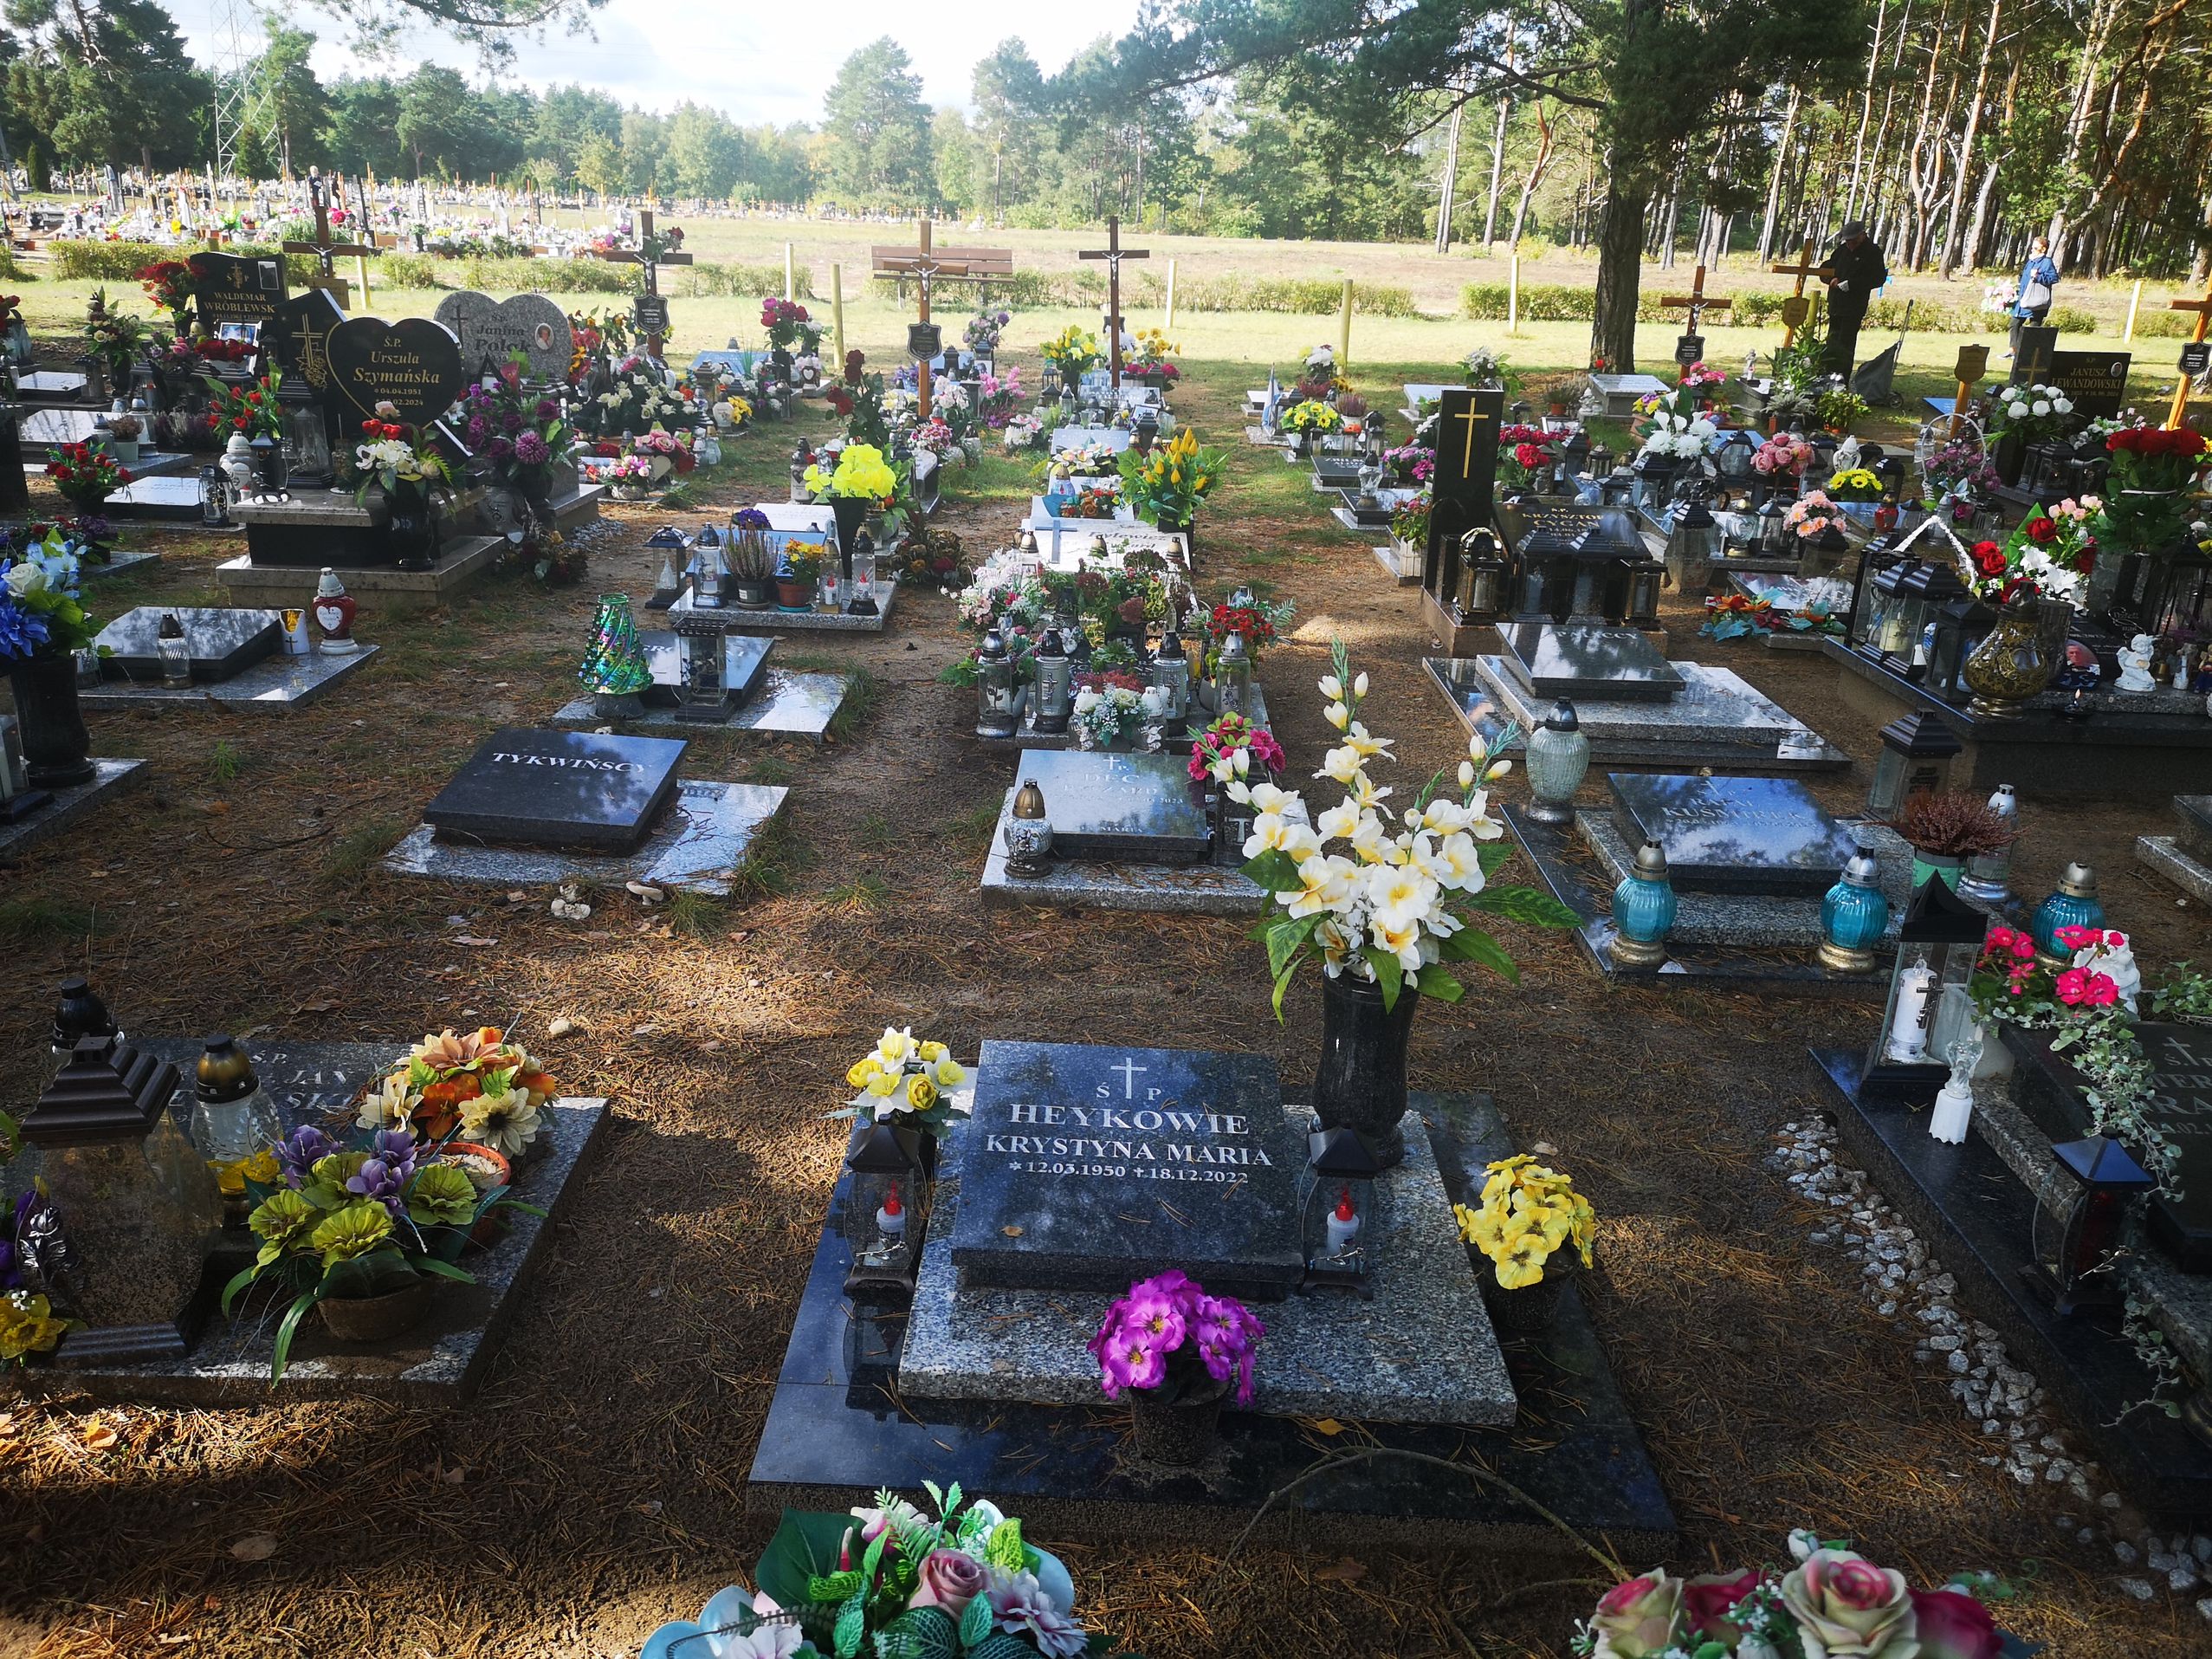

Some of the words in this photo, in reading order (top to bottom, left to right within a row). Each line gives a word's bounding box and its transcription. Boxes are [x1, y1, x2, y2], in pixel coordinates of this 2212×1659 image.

[214, 291, 267, 302] WALDEMAR
[204, 301, 276, 314] WRÓBLEWSK
[476, 325, 524, 336] Janina
[371, 351, 420, 364] Urszula
[353, 366, 440, 385] Szymańska
[2070, 367, 2106, 377] JANUSZ
[1147, 1087, 1162, 1101] P
[1009, 1104, 1250, 1136] HEYKOWIE
[986, 1134, 1156, 1161] KRYSTYNA
[1167, 1144, 1274, 1167] MARIA
